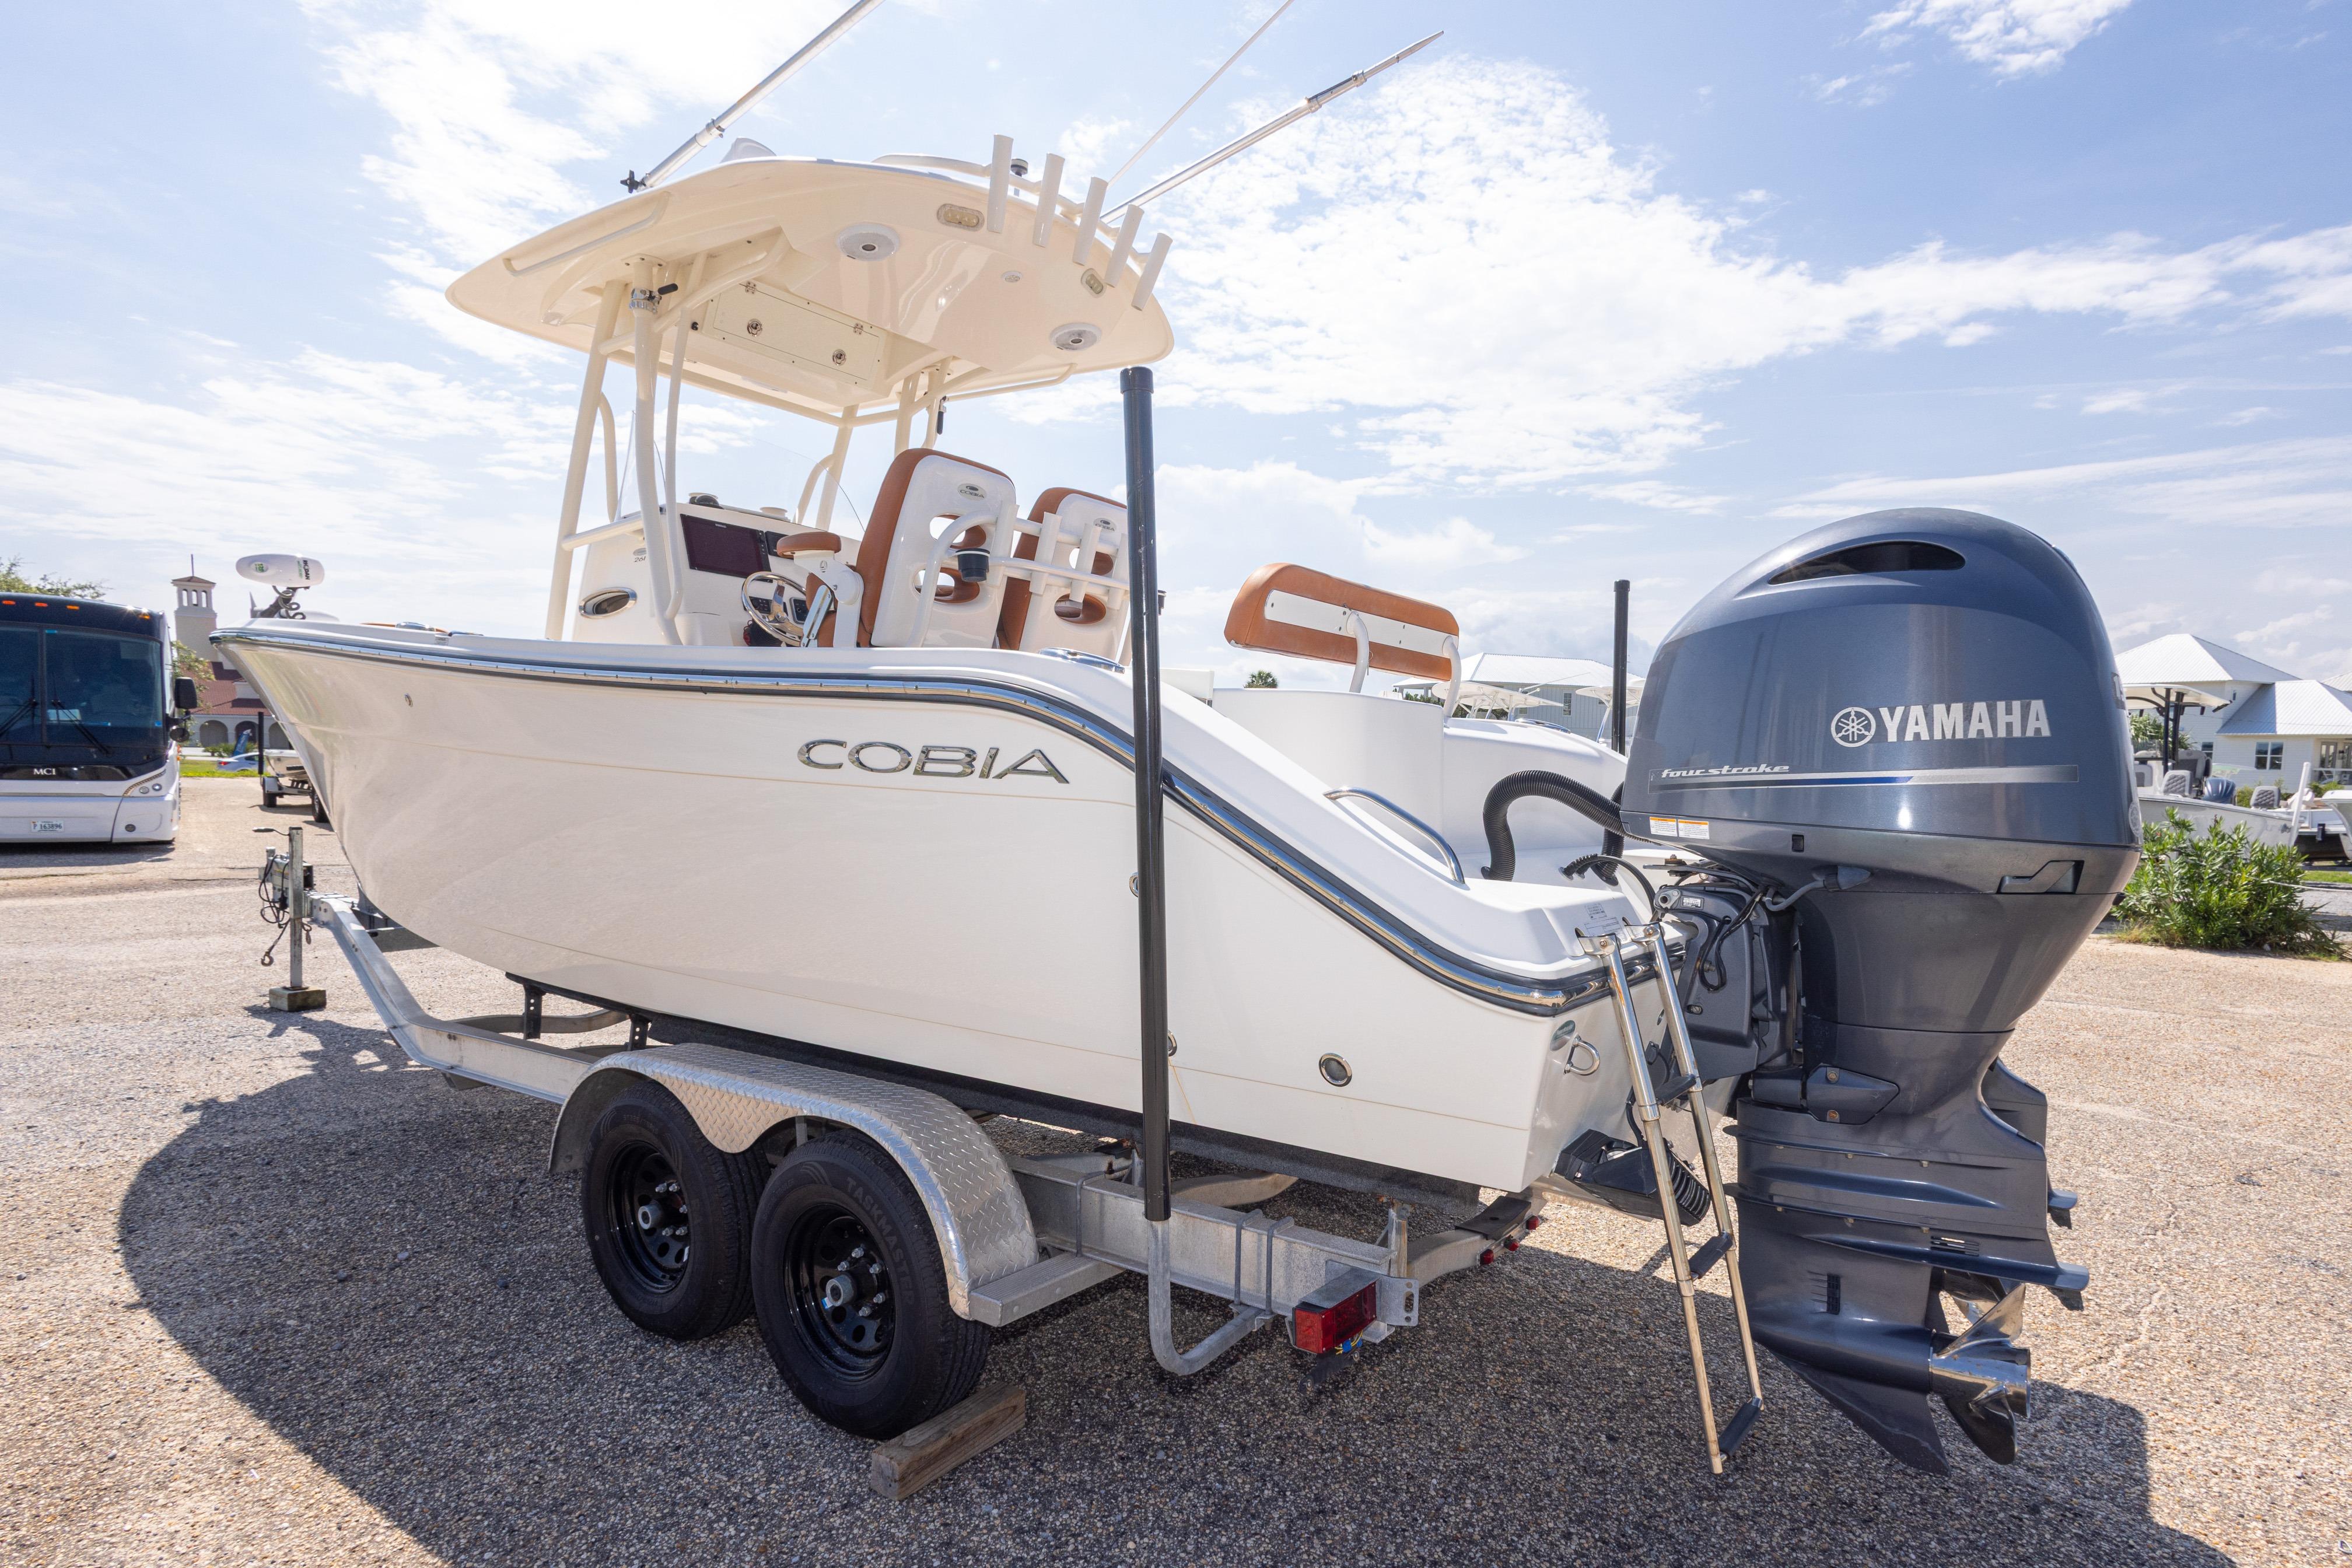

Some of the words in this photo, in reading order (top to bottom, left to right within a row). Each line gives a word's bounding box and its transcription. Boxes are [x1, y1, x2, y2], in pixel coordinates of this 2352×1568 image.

[960, 490, 985, 498] COBIA
[1879, 699, 2051, 743] YAMAHA
[797, 739, 1070, 785] COBIA
[846, 1176, 915, 1305] TASKMASTER
